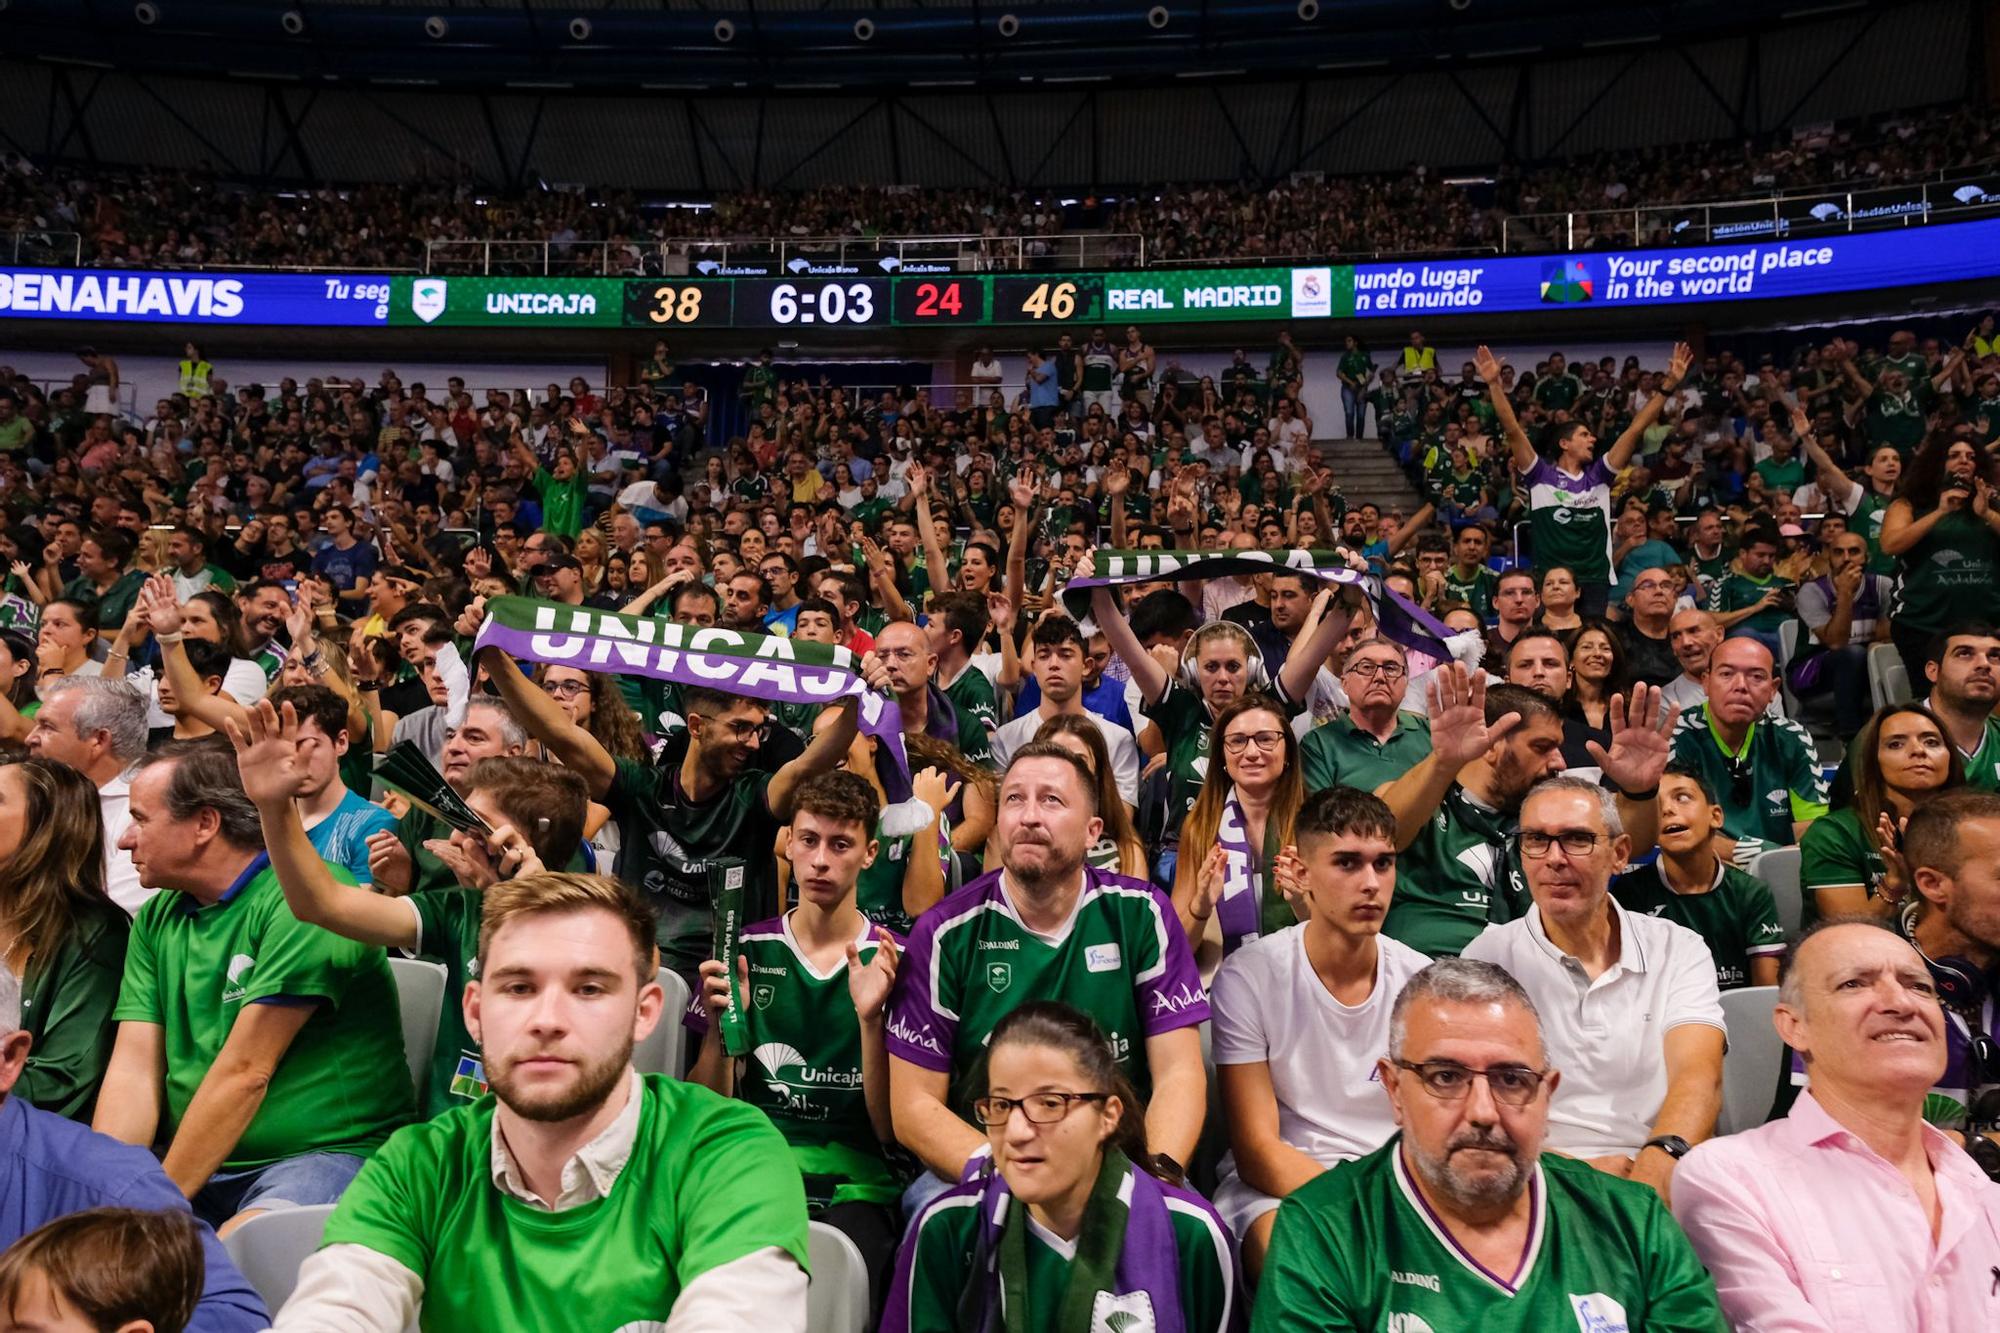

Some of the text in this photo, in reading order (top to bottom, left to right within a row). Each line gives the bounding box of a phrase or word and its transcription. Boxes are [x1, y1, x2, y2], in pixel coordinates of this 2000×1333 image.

[1606, 247, 1833, 278] Your second place
[324, 279, 350, 299] Tu
[1421, 266, 1483, 290] lugar
[1606, 271, 1753, 300] in the world
[486, 293, 596, 315] UNICAJA
[649, 286, 702, 323] 38
[770, 283, 874, 324] 6:03
[914, 282, 962, 316] 24
[1020, 282, 1076, 319] 46
[1108, 288, 1174, 310] REAL
[1183, 285, 1281, 308] MADRID
[1375, 289, 1398, 310] el
[1402, 286, 1483, 308] mundo
[726, 909, 735, 932] ESTE
[978, 939, 1020, 950] SPALDING
[751, 963, 787, 977] SPALDING
[800, 1066, 863, 1088] Unicaja
[1391, 1270, 1441, 1293] ALDING
